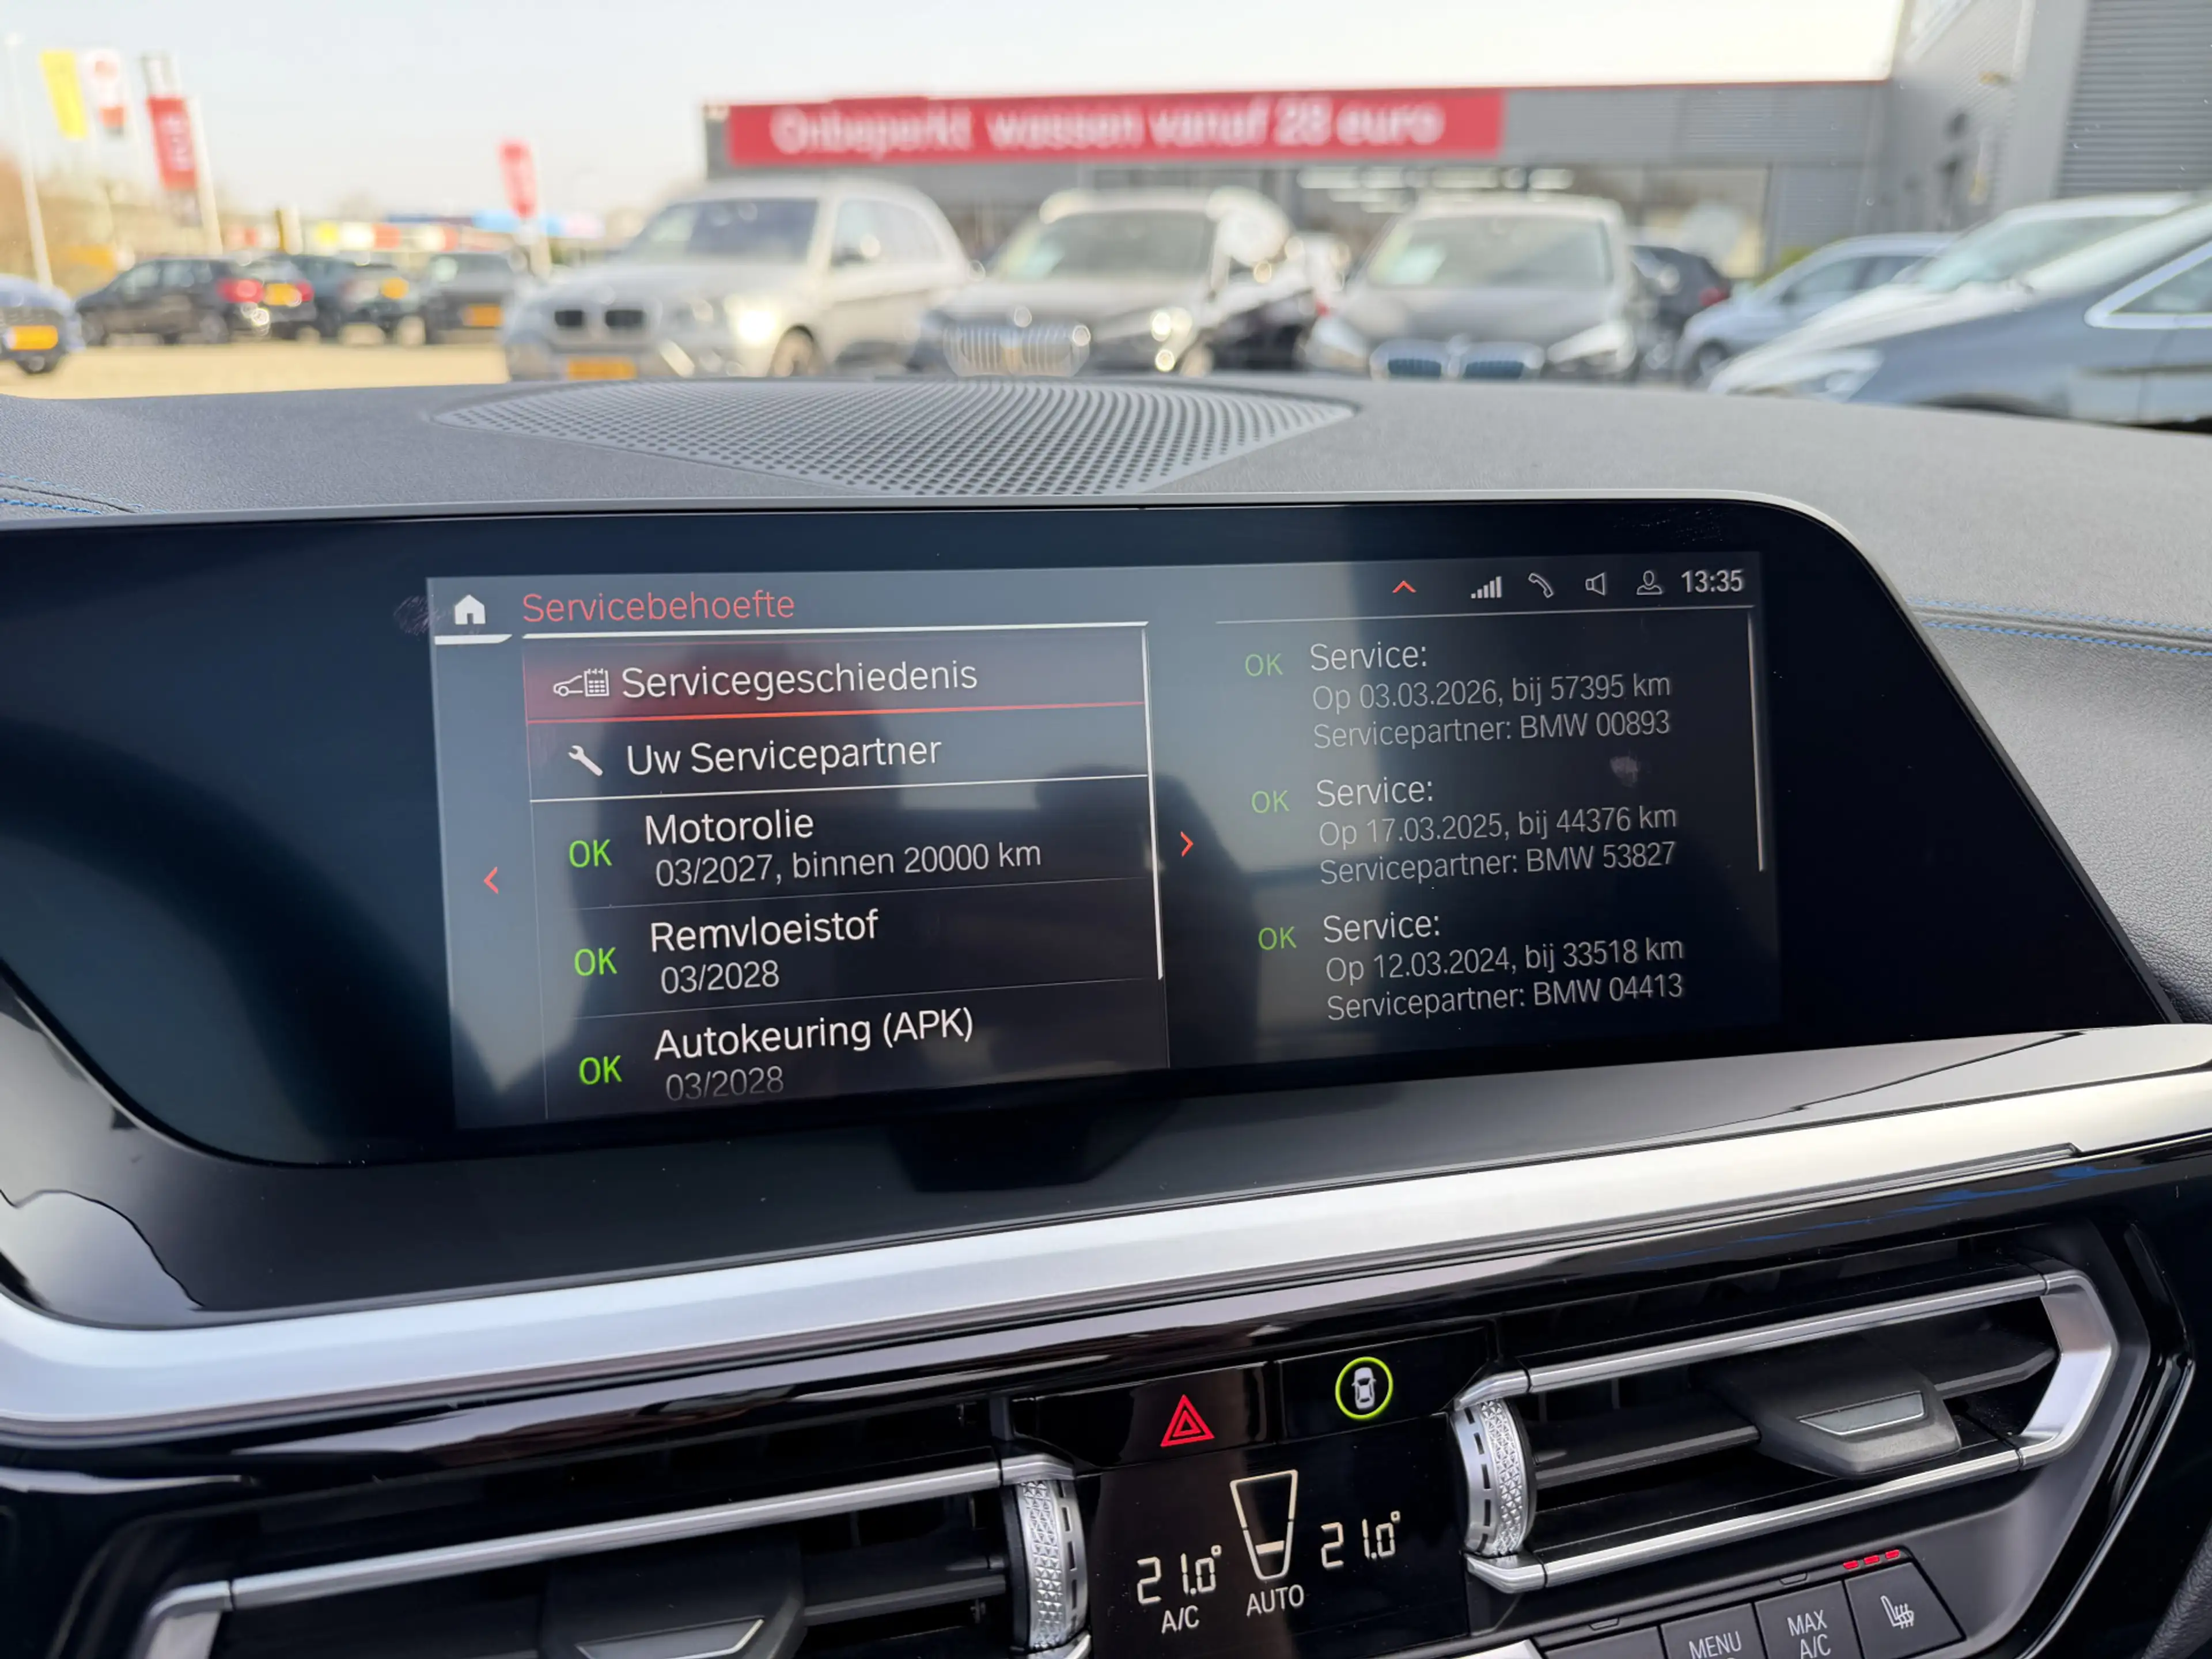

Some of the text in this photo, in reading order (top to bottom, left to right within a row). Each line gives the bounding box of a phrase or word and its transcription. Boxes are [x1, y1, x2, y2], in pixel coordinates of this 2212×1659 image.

[986, 107, 1144, 149] wassen
[1148, 97, 1269, 146] vanaf
[1335, 100, 1445, 145] euro
[1681, 569, 1744, 594] 13:35
[522, 590, 795, 622] Servicebehoefte
[1245, 653, 1283, 677] OK
[1310, 641, 1427, 671] Service:
[622, 660, 979, 702] Servicegeschiedenis
[1313, 673, 1671, 715] Op 03.03.2026, bij 57395 km
[1314, 709, 1671, 749] Servicepartner: BMW 00893
[627, 737, 942, 775] Uw Servicepartner
[1251, 790, 1290, 814] OK
[1316, 777, 1434, 807] Service:
[645, 809, 814, 846] Motorolie
[1319, 805, 1677, 850] Op 17.03.2025, bij 44376 km
[569, 839, 612, 868] OK
[655, 842, 1041, 887] 03/2027, binnen 20000 km
[1320, 841, 1676, 885] Servicepartner: BMW 53827
[651, 908, 879, 952] Remvloeistof
[1257, 926, 1297, 950] OK
[1323, 911, 1441, 943] Service:
[574, 946, 618, 976] OK
[660, 960, 780, 994] 03/2028
[1326, 937, 1684, 986] Op 12.03.2024, bij 33518 km
[1327, 972, 1683, 1021] Servicepartner: BMW 04413
[654, 1007, 974, 1060] Autokeuring (APK)
[579, 1055, 623, 1085] OK
[665, 1065, 784, 1101] 03/2028
[1247, 1585, 1305, 1616] AUTO
[1161, 1605, 1200, 1634] A/C
[1787, 1609, 1828, 1637] MAX
[1689, 1631, 1743, 1659] MENU
[1800, 1634, 1831, 1659] A/C
